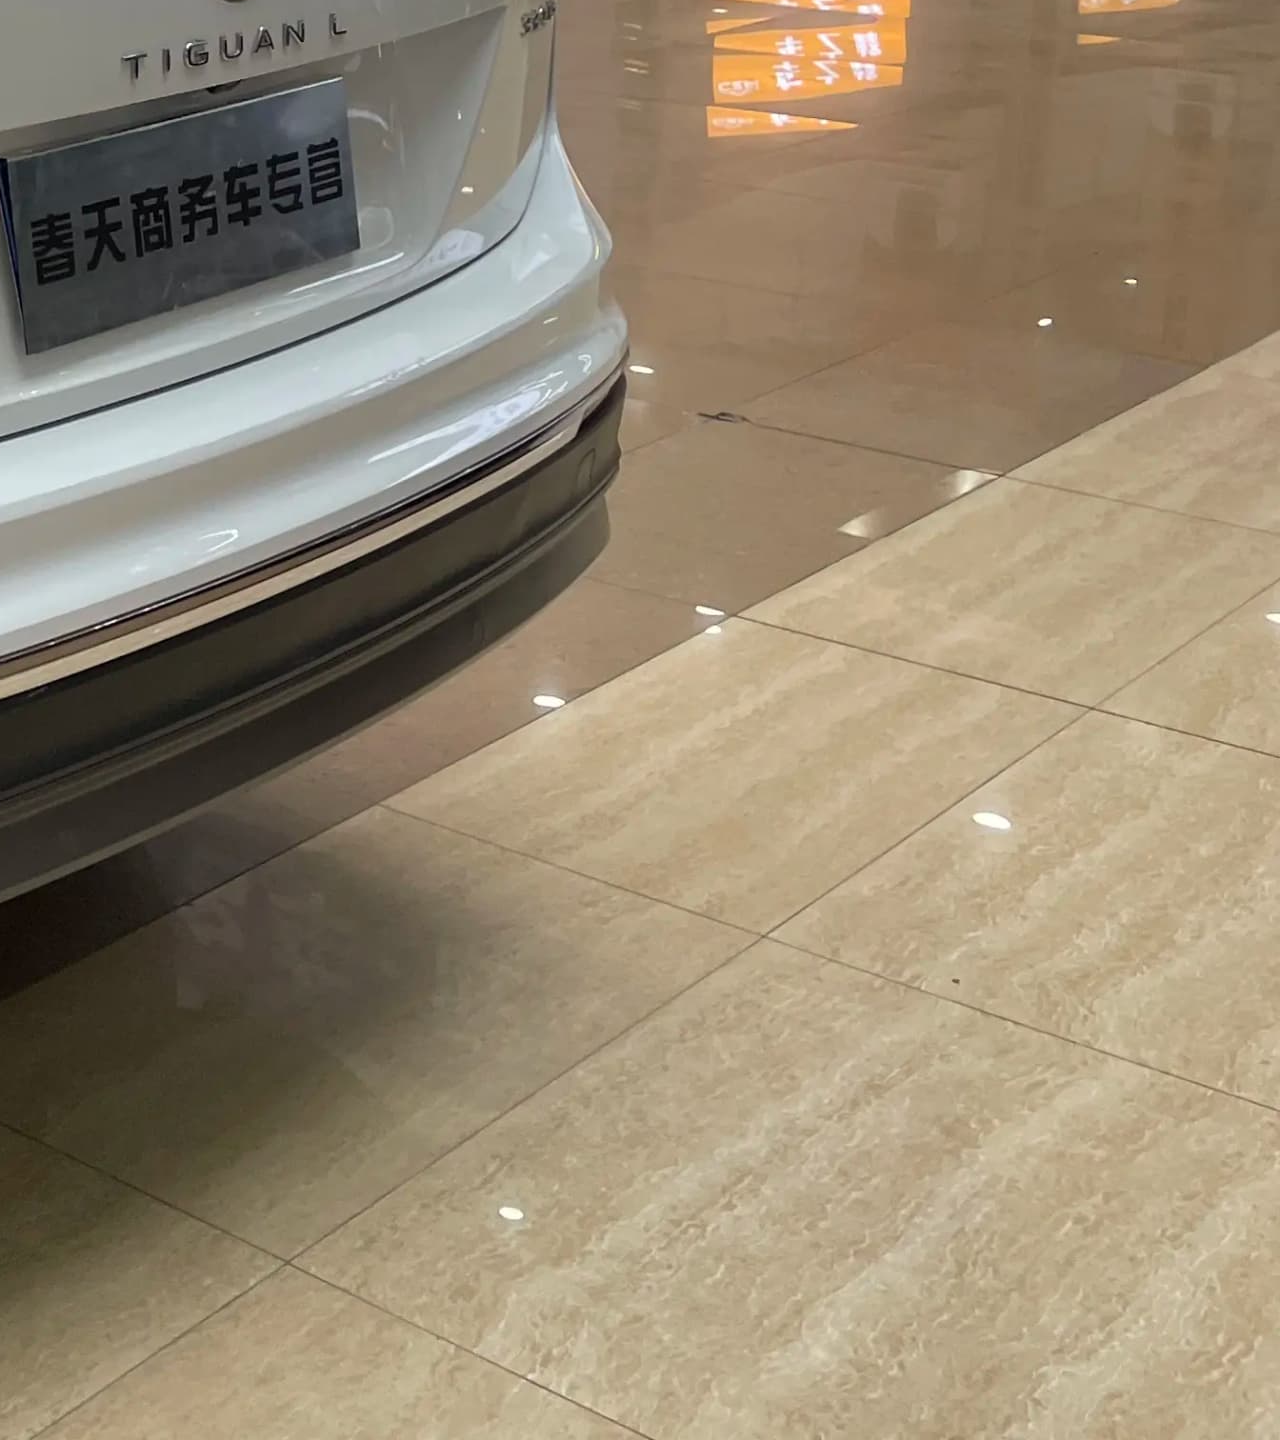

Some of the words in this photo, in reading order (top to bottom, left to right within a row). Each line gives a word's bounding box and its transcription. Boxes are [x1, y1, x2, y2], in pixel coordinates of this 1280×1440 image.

[121, 19, 306, 81] TIGUAN
[328, 13, 347, 37] L
[31, 137, 344, 286] 春天商务车专营
